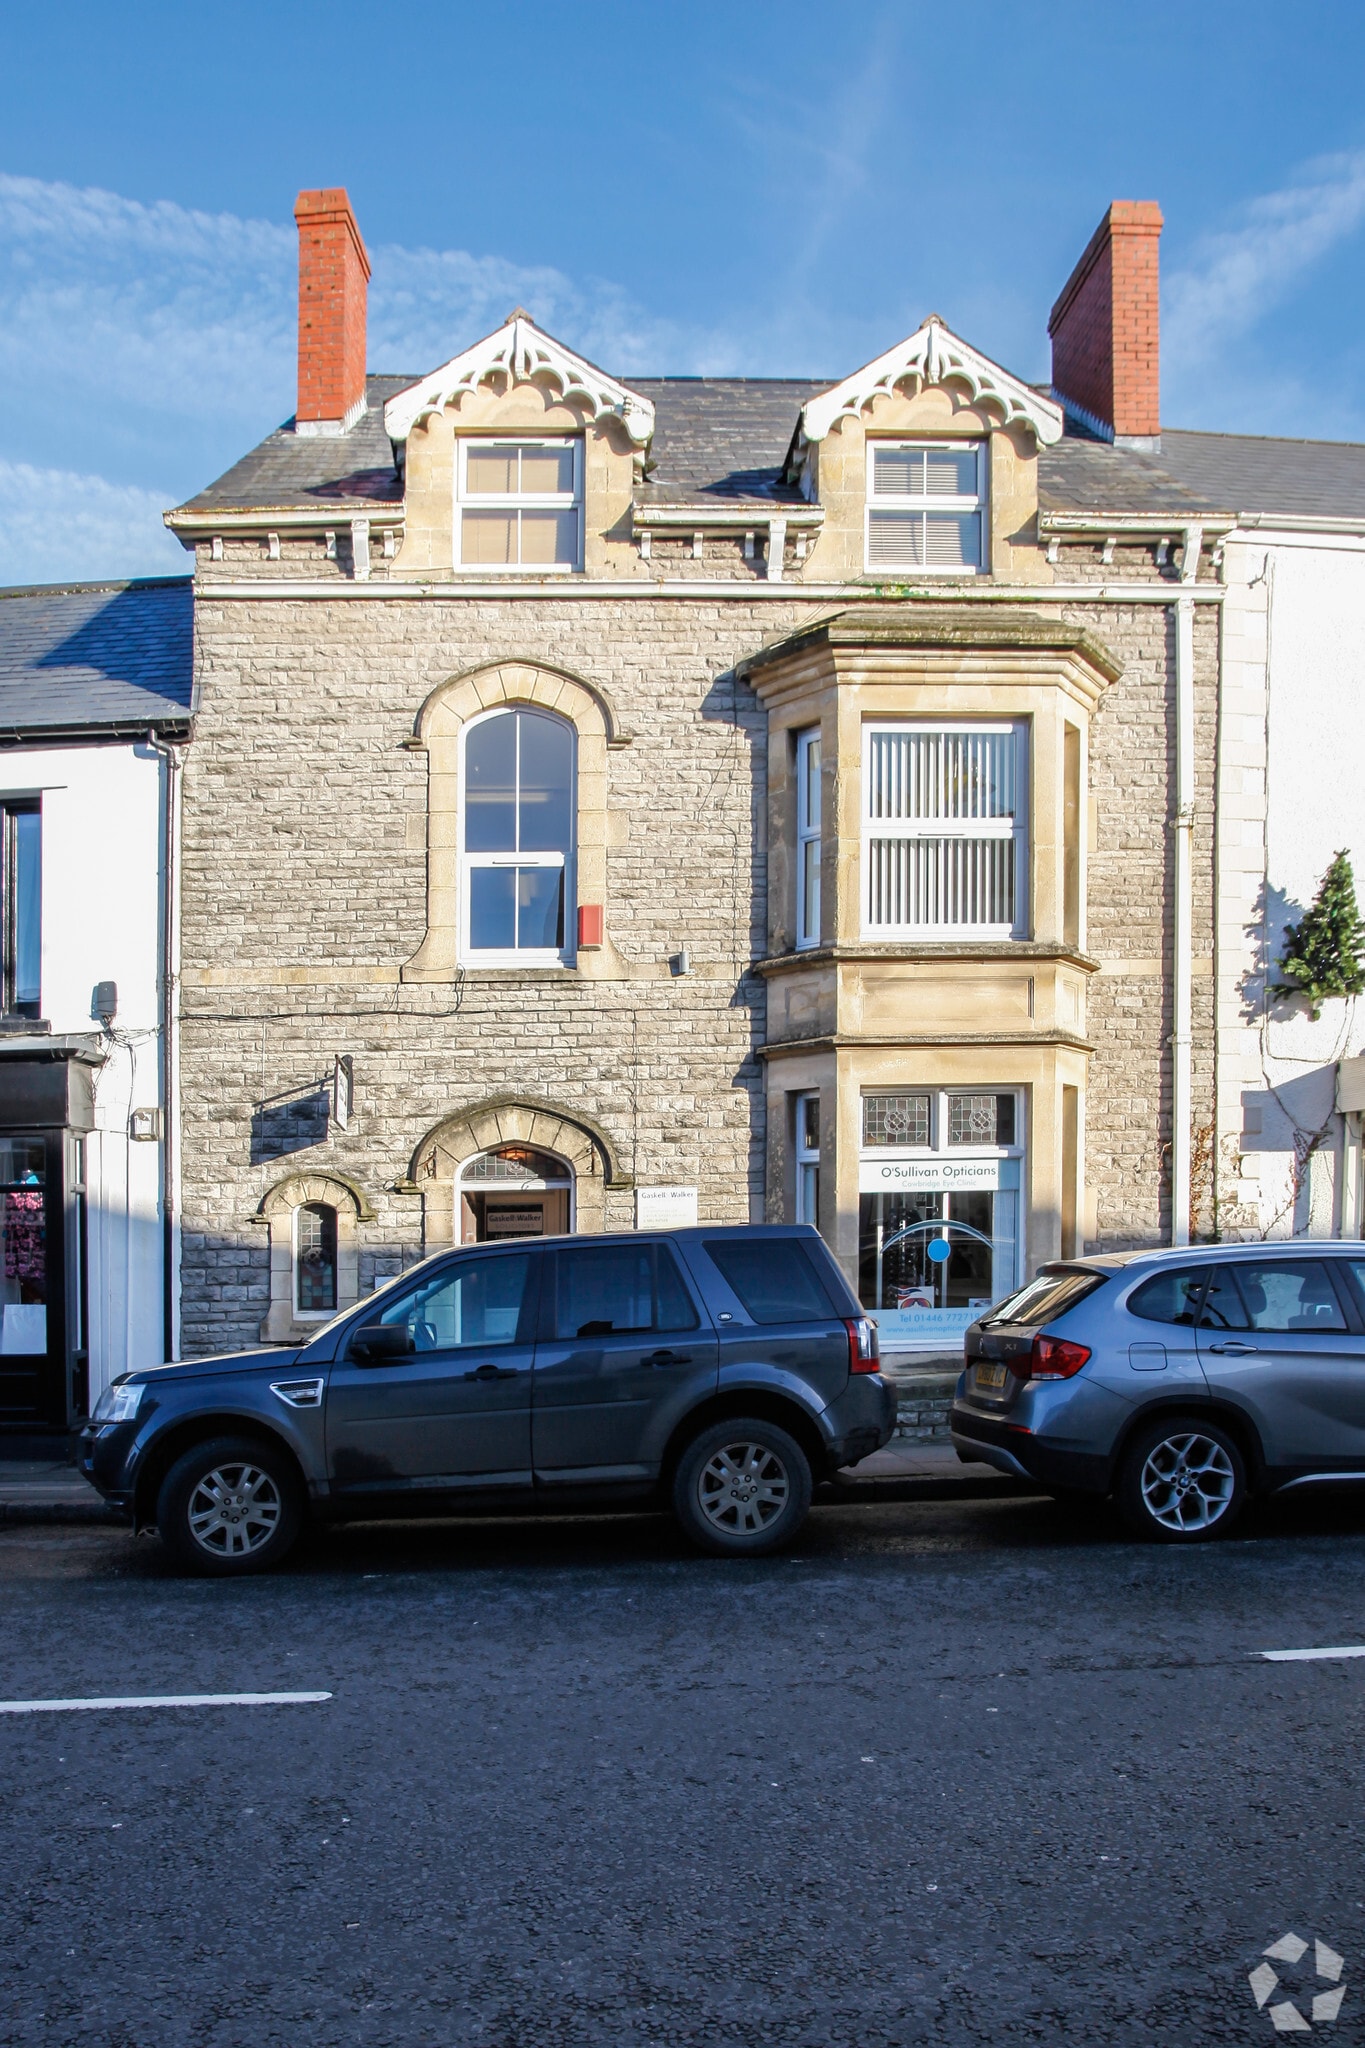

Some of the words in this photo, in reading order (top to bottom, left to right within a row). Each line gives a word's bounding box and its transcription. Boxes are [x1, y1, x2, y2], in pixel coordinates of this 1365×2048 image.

[881, 1166, 938, 1178] O'Sullivan
[942, 1165, 996, 1178] Opticians
[901, 1180, 940, 1188] Cowbridge
[943, 1179, 955, 1187] Eye
[957, 1178, 976, 1187] Clinic
[641, 1191, 666, 1199] Gaskell
[489, 1214, 515, 1222] Gaskell
[516, 1213, 541, 1221] Walker
[899, 1314, 911, 1323] Tel
[914, 1313, 943, 1323] 01446
